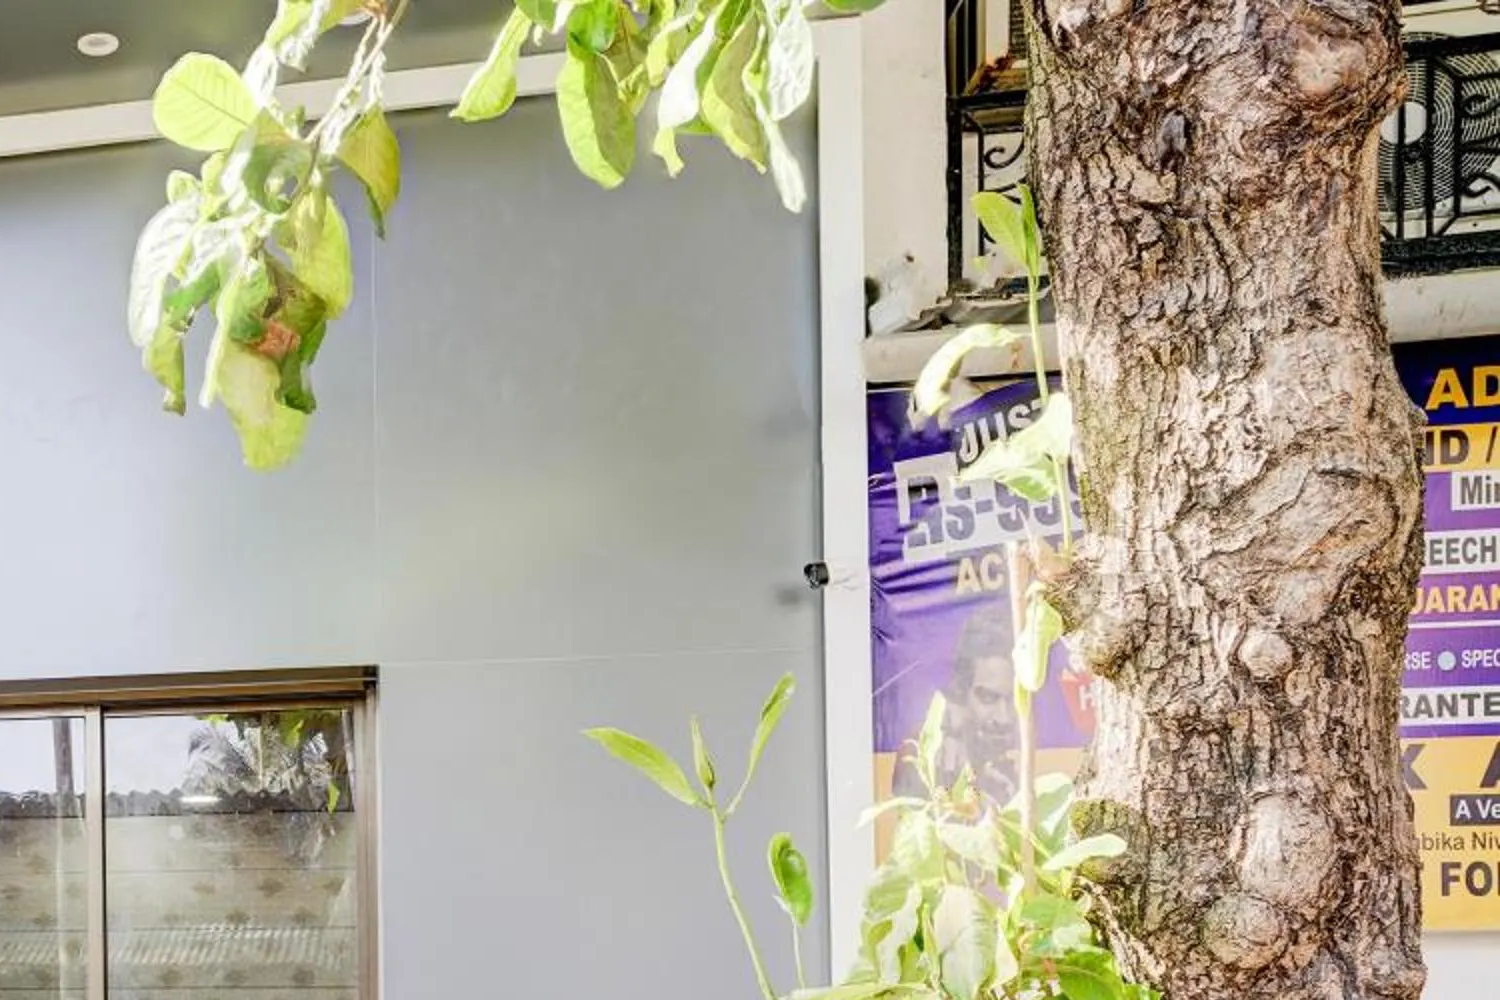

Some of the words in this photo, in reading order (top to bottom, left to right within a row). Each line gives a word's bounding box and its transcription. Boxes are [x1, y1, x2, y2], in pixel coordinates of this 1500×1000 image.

[1425, 365, 1500, 411] AD
[959, 398, 1043, 463] JUS
[1456, 799, 1472, 819] A
[1418, 832, 1465, 851] bika
[1441, 860, 1500, 897] FO
